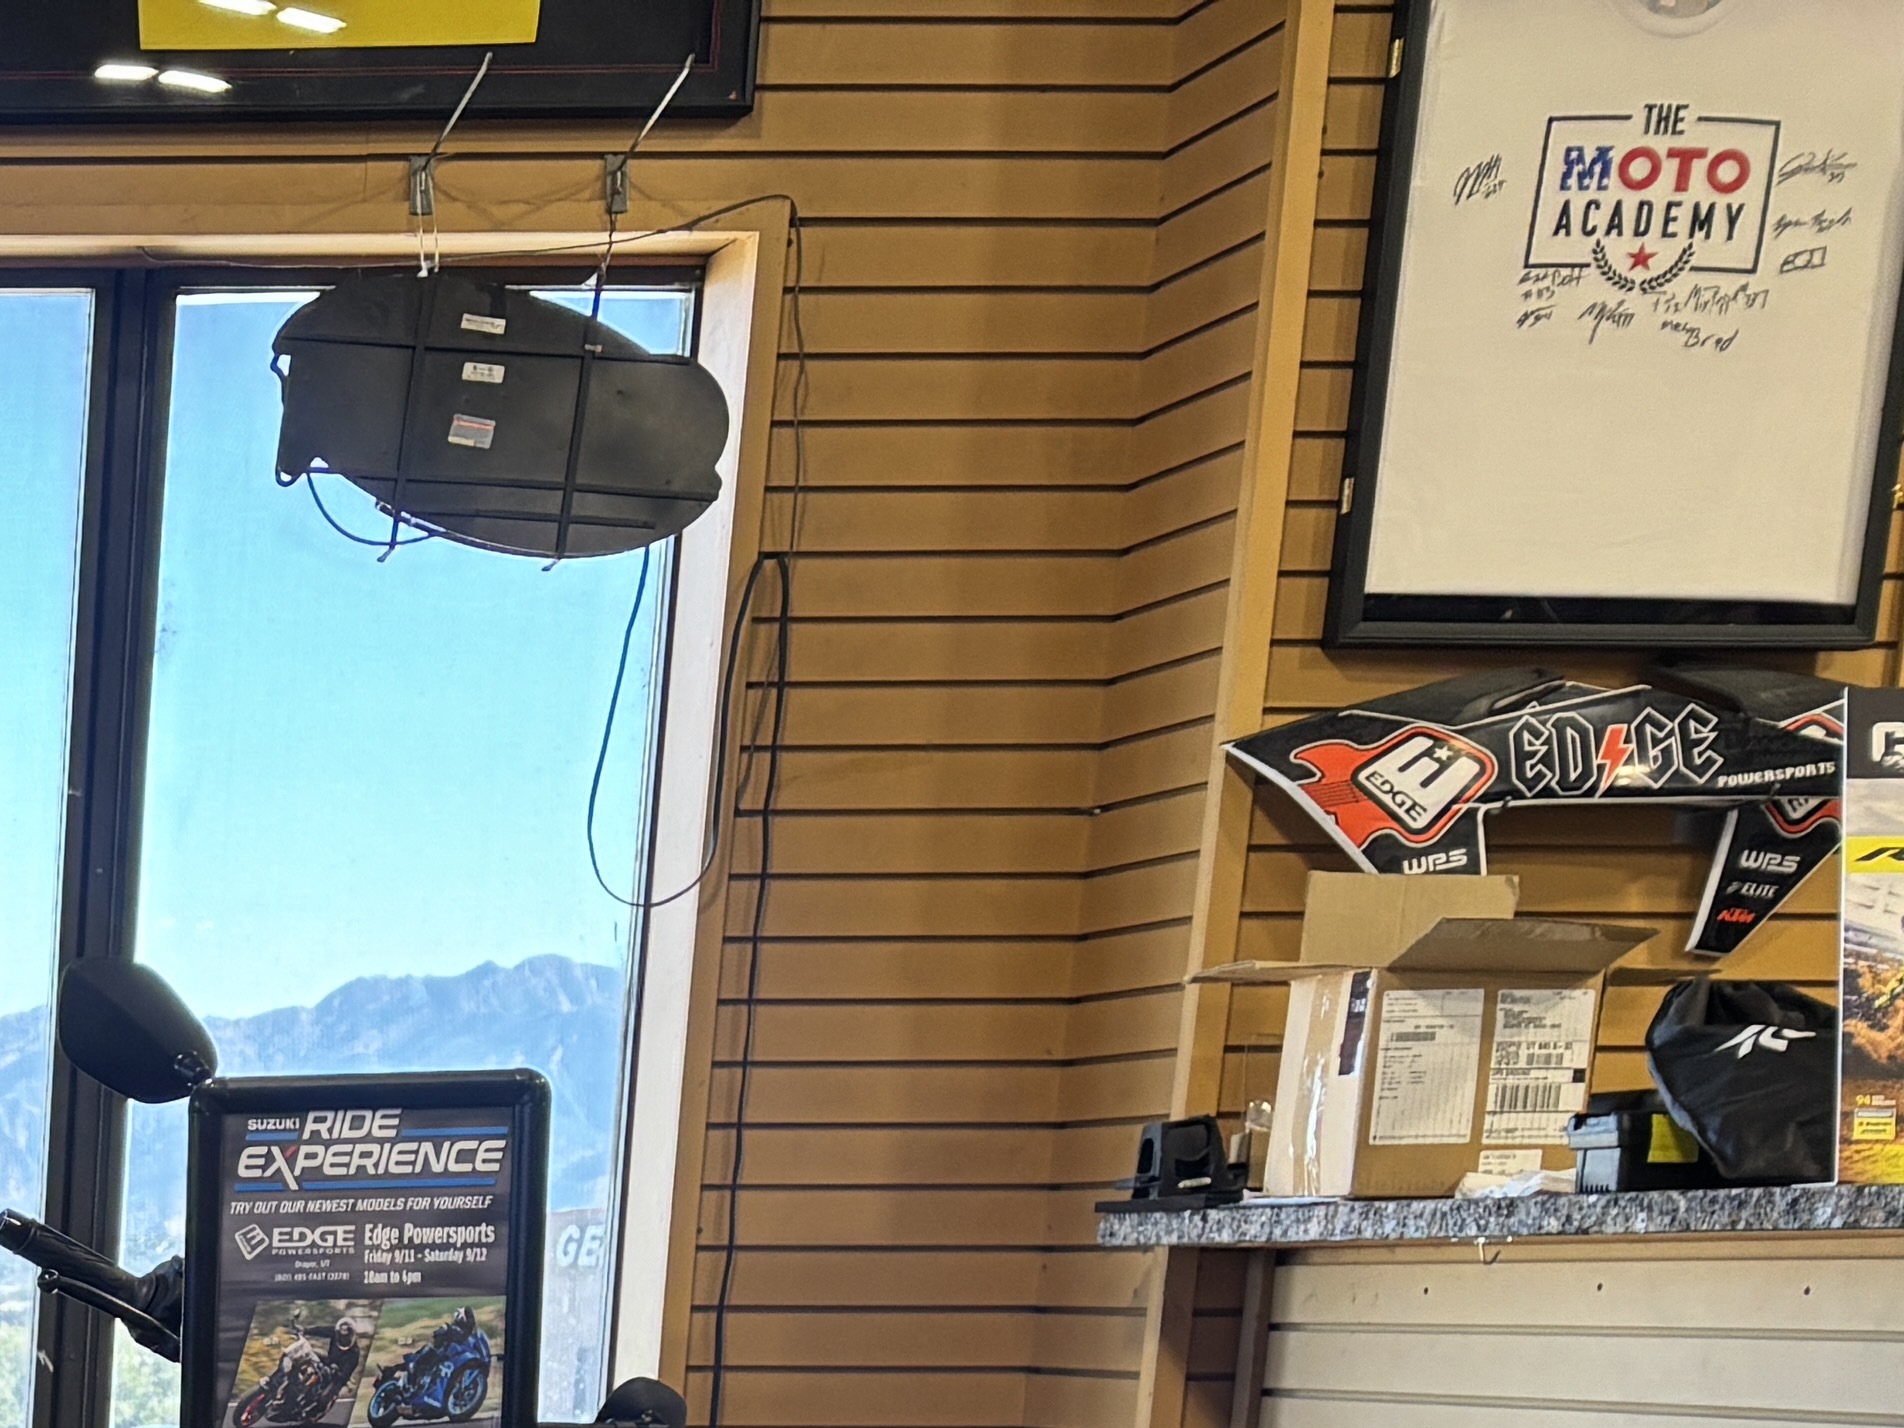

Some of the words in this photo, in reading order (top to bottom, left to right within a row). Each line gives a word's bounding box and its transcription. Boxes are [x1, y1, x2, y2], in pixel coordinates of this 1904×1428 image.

[1643, 104, 1689, 136] THE
[1560, 145, 1751, 194] MOTO
[1553, 200, 1746, 242] ACADEMY
[1716, 763, 1836, 788] POWERSPORTS
[1365, 769, 1428, 823] EDGE
[1402, 848, 1468, 876] WPS
[1739, 849, 1800, 875] WPS
[247, 1117, 300, 1131] SUZUKI
[302, 1107, 402, 1141] RIDE
[237, 1139, 507, 1191] EXPERIENCE
[230, 1201, 253, 1215] TRY
[253, 1200, 278, 1214] OUT
[279, 1199, 305, 1214] OUR
[306, 1198, 355, 1213] NEWEST
[355, 1197, 405, 1212] MODELS
[406, 1196, 431, 1211] FOR
[433, 1195, 493, 1210] YOURSELF
[272, 1225, 355, 1248] EDGE
[364, 1223, 400, 1250] Edge
[403, 1222, 495, 1248] Powersports
[272, 1247, 355, 1256] POWERSPORTS
[364, 1249, 392, 1265] Friday
[424, 1247, 464, 1264] Saturday
